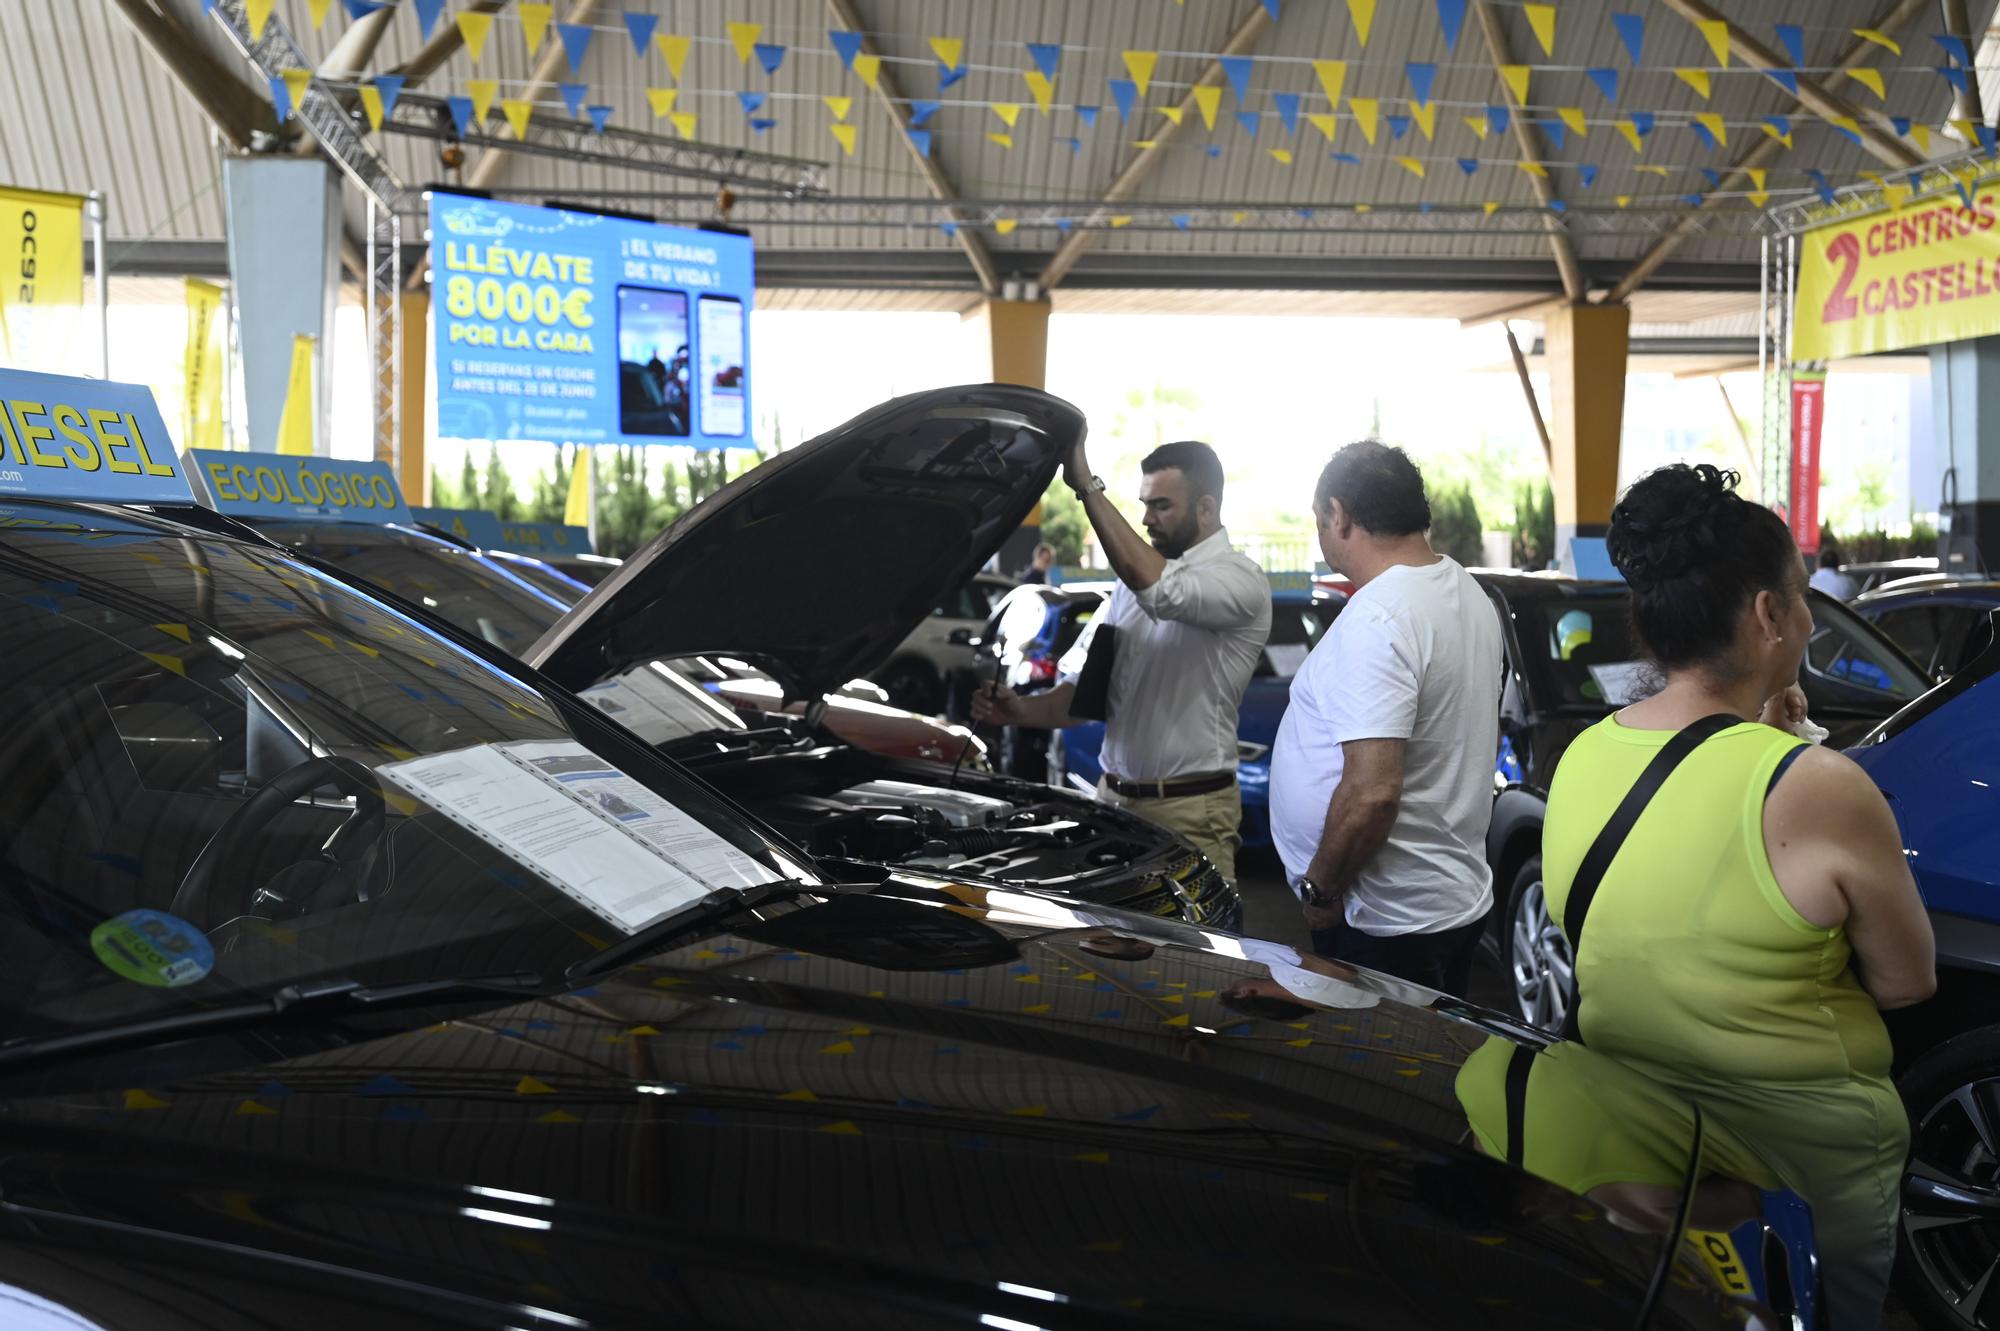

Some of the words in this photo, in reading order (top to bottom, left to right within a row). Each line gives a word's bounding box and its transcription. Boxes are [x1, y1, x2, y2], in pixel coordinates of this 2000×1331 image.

[1867, 196, 1996, 257] CENTROS
[446, 238, 594, 285] LLÉVATE
[624, 261, 648, 280] DE
[648, 264, 673, 284] TU
[652, 241, 718, 267] VERANO
[1822, 231, 1860, 325] 2
[447, 275, 594, 328] 8000€
[450, 322, 497, 345] POR
[502, 327, 532, 348] LA
[535, 330, 594, 353] CARA
[0, 399, 176, 477] IESEL
[207, 461, 396, 509] ECOLÓGICO
